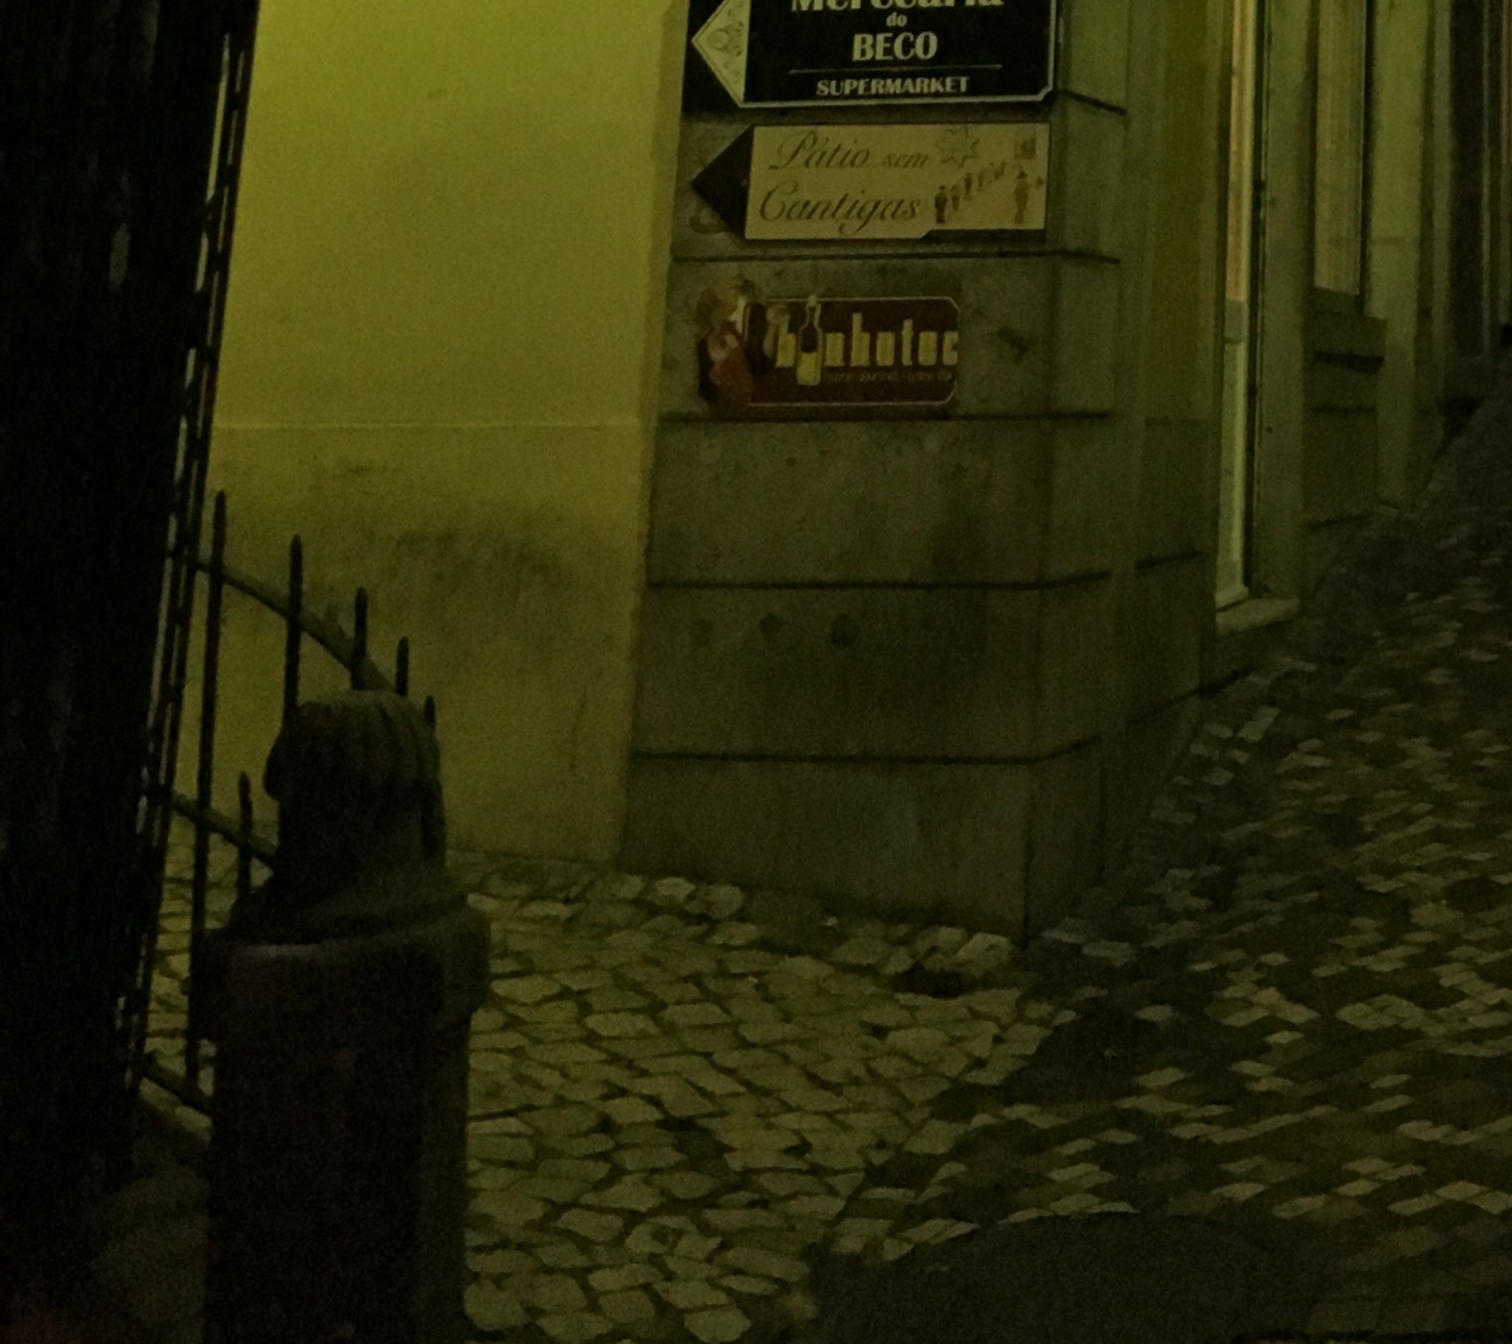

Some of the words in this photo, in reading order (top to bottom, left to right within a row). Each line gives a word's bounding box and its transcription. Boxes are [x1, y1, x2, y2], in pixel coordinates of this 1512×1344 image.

[886, 12, 908, 28] do
[852, 31, 938, 62] BECO
[816, 76, 970, 97] SUPERMARKET
[768, 130, 871, 170] Pátio
[881, 151, 928, 169] sem
[759, 179, 922, 237] Cantigas
